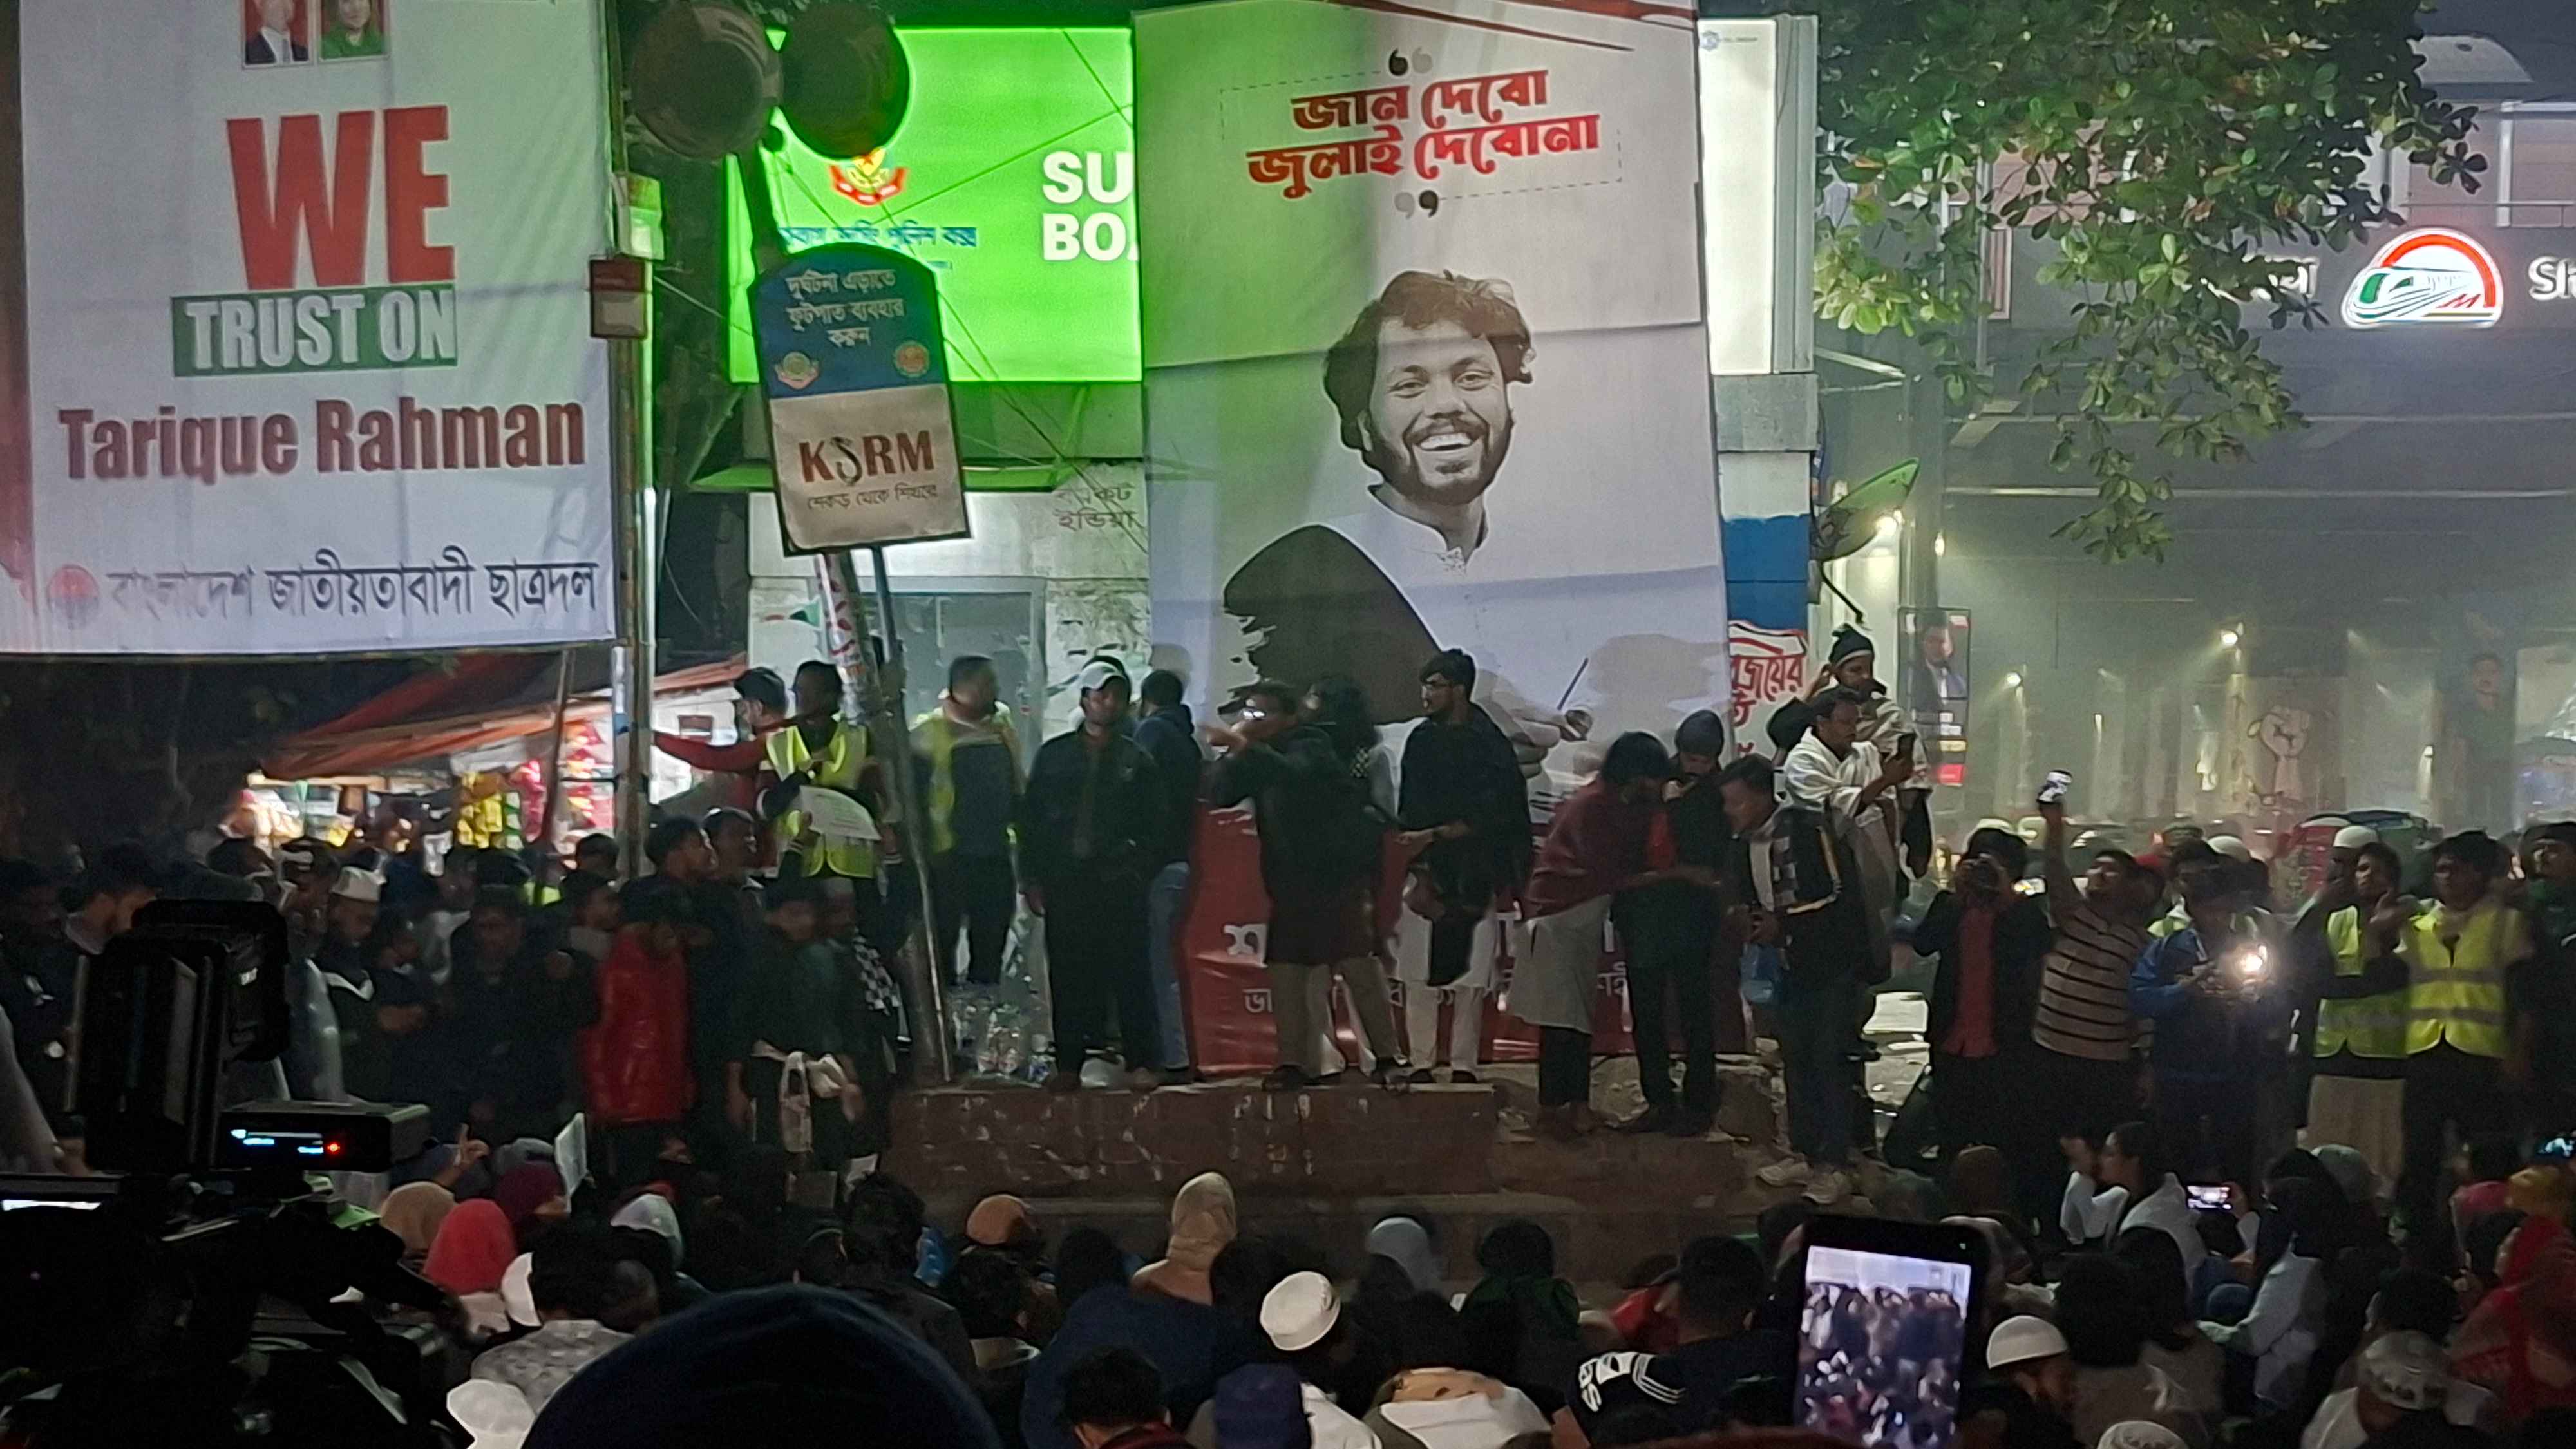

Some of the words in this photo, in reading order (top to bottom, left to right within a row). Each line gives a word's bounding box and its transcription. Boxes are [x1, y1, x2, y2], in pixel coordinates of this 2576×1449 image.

[1290, 84, 1410, 130] জান
[1421, 70, 1549, 129] দেবো
[1042, 150, 1135, 204] SU
[1245, 125, 1405, 199] জুলাই
[1413, 114, 1601, 181] দেবোনা
[225, 104, 456, 291] WE
[1042, 211, 1139, 261] BO
[185, 292, 365, 370] TRUST
[380, 290, 456, 361] ON
[59, 406, 298, 484] Tarique
[315, 397, 586, 473] Rahman
[799, 430, 935, 486] KSRM
[264, 545, 475, 616] জাতীয়তাবাদী
[484, 558, 599, 618] ছাত্রদল
